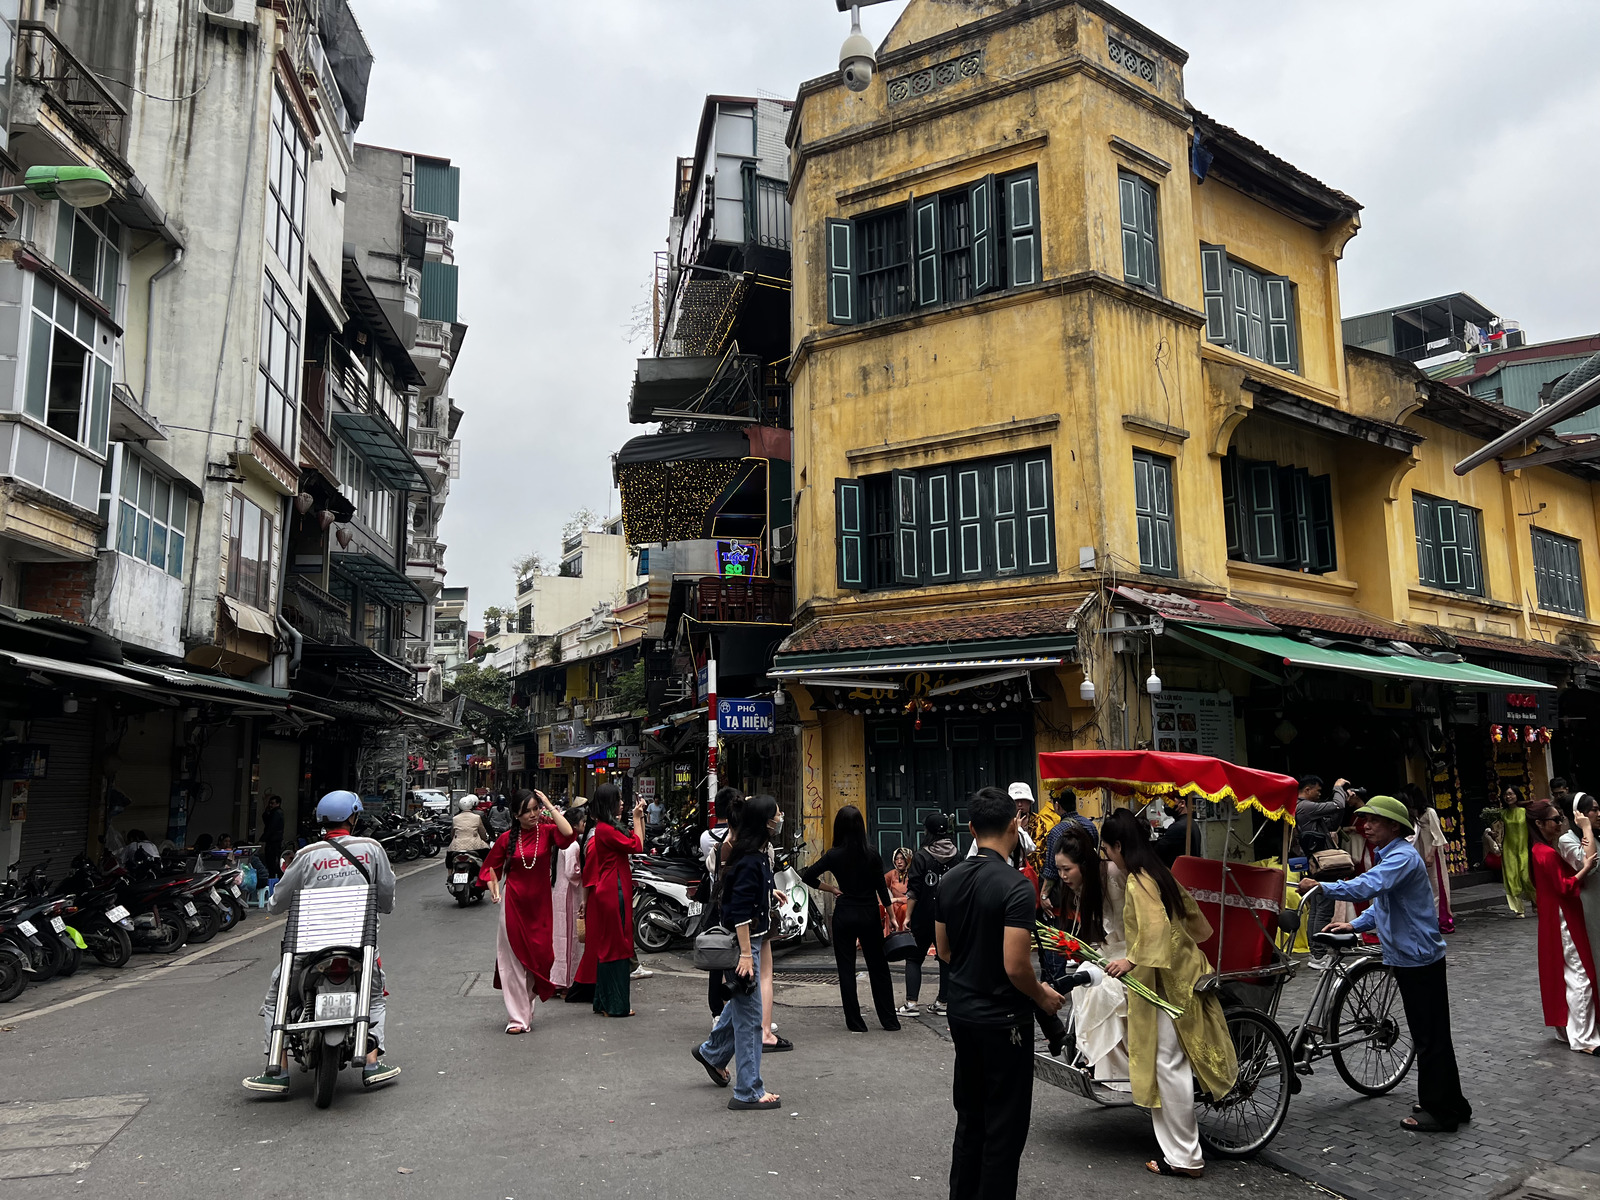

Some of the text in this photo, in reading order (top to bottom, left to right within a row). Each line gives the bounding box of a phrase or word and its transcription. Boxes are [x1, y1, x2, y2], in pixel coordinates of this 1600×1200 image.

[722, 552, 749, 565] Tiger
[737, 703, 756, 713] PHỐ
[725, 713, 768, 730] TẠ HIỆN
